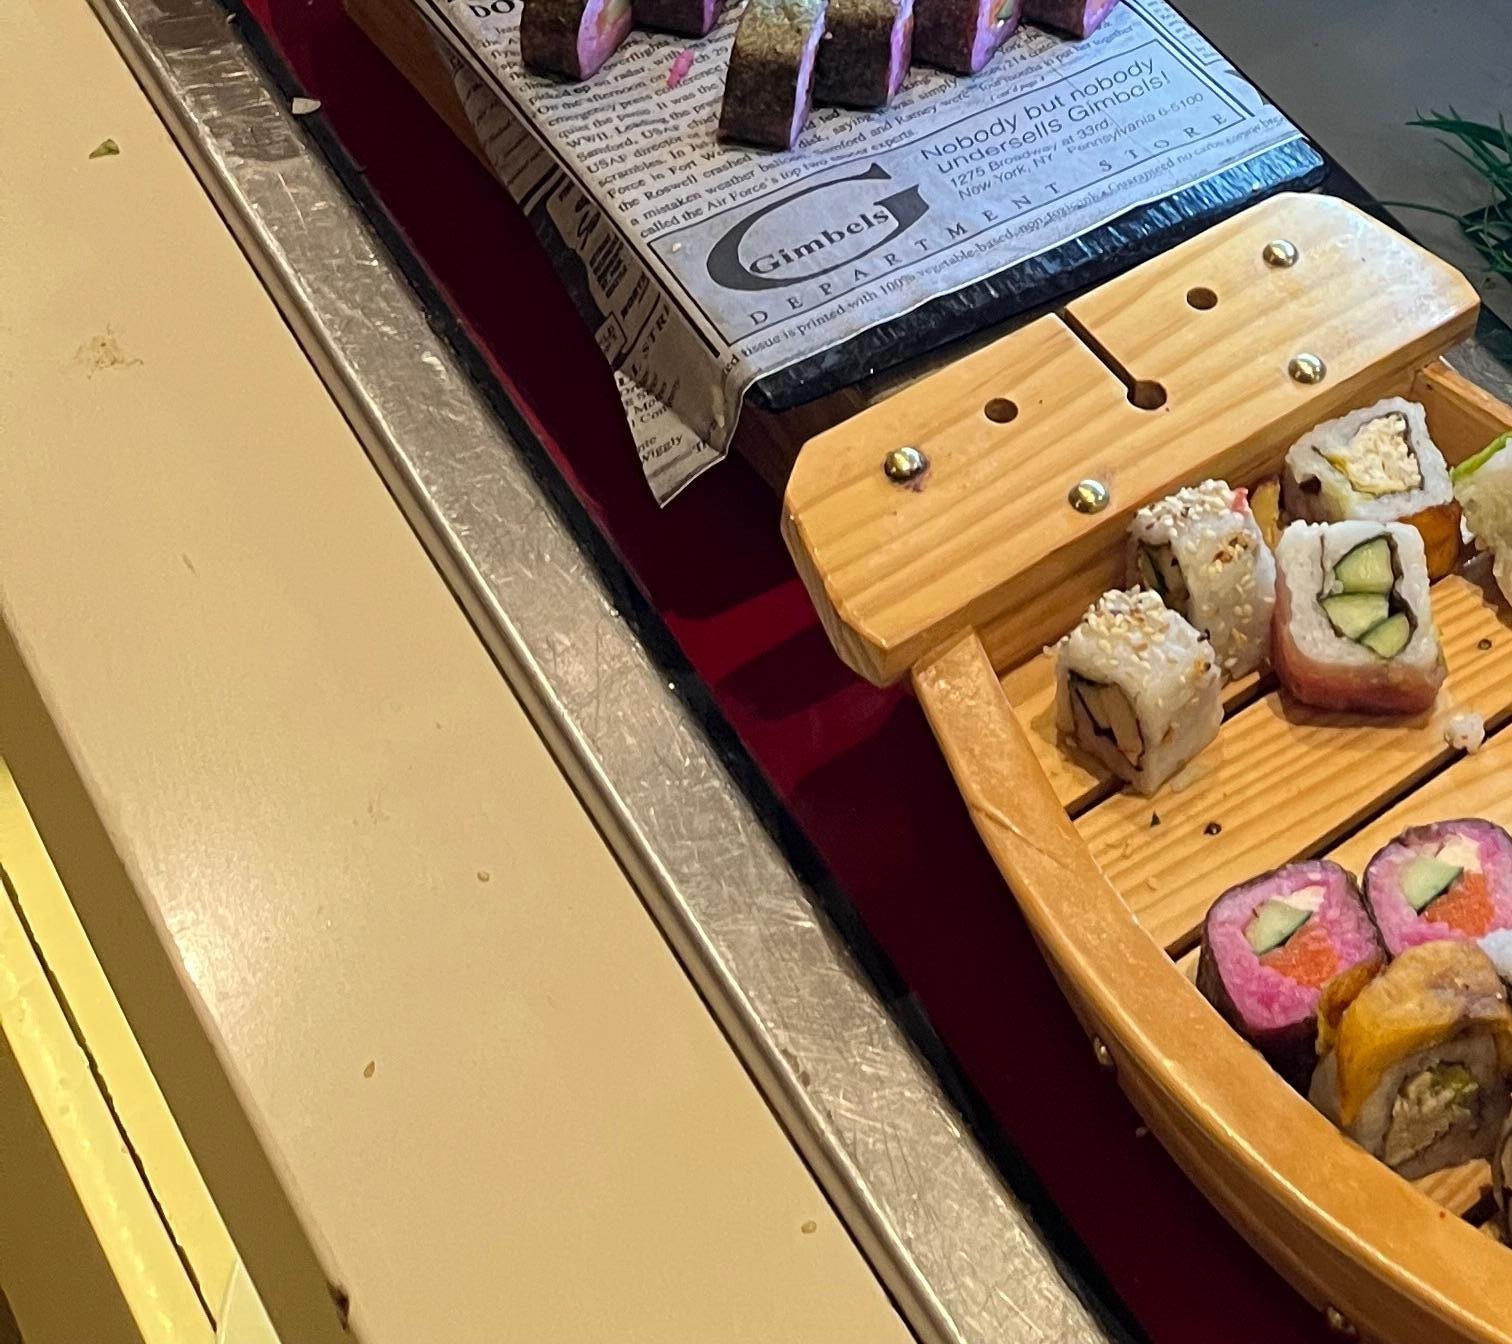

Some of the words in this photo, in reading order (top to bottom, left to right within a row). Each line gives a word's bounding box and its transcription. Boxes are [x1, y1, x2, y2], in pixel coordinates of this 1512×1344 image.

[916, 110, 1029, 166] Nobody
[1018, 93, 1067, 120] but
[1062, 54, 1164, 104] nobody
[934, 115, 1067, 178] undersells
[1062, 69, 1175, 123] Gimbels!
[641, 173, 700, 201] Roswell
[698, 152, 753, 178] crashed
[947, 165, 988, 188] 1275
[954, 177, 997, 200] New
[1030, 151, 1057, 167] NY
[636, 215, 680, 238] called
[679, 205, 705, 221] the
[703, 196, 728, 211] Air
[744, 206, 893, 277] Gimbels
[746, 181, 1064, 326] DEPARTMENT
[1095, 109, 1230, 175] STORE
[793, 305, 849, 336] printed
[845, 290, 879, 309] with
